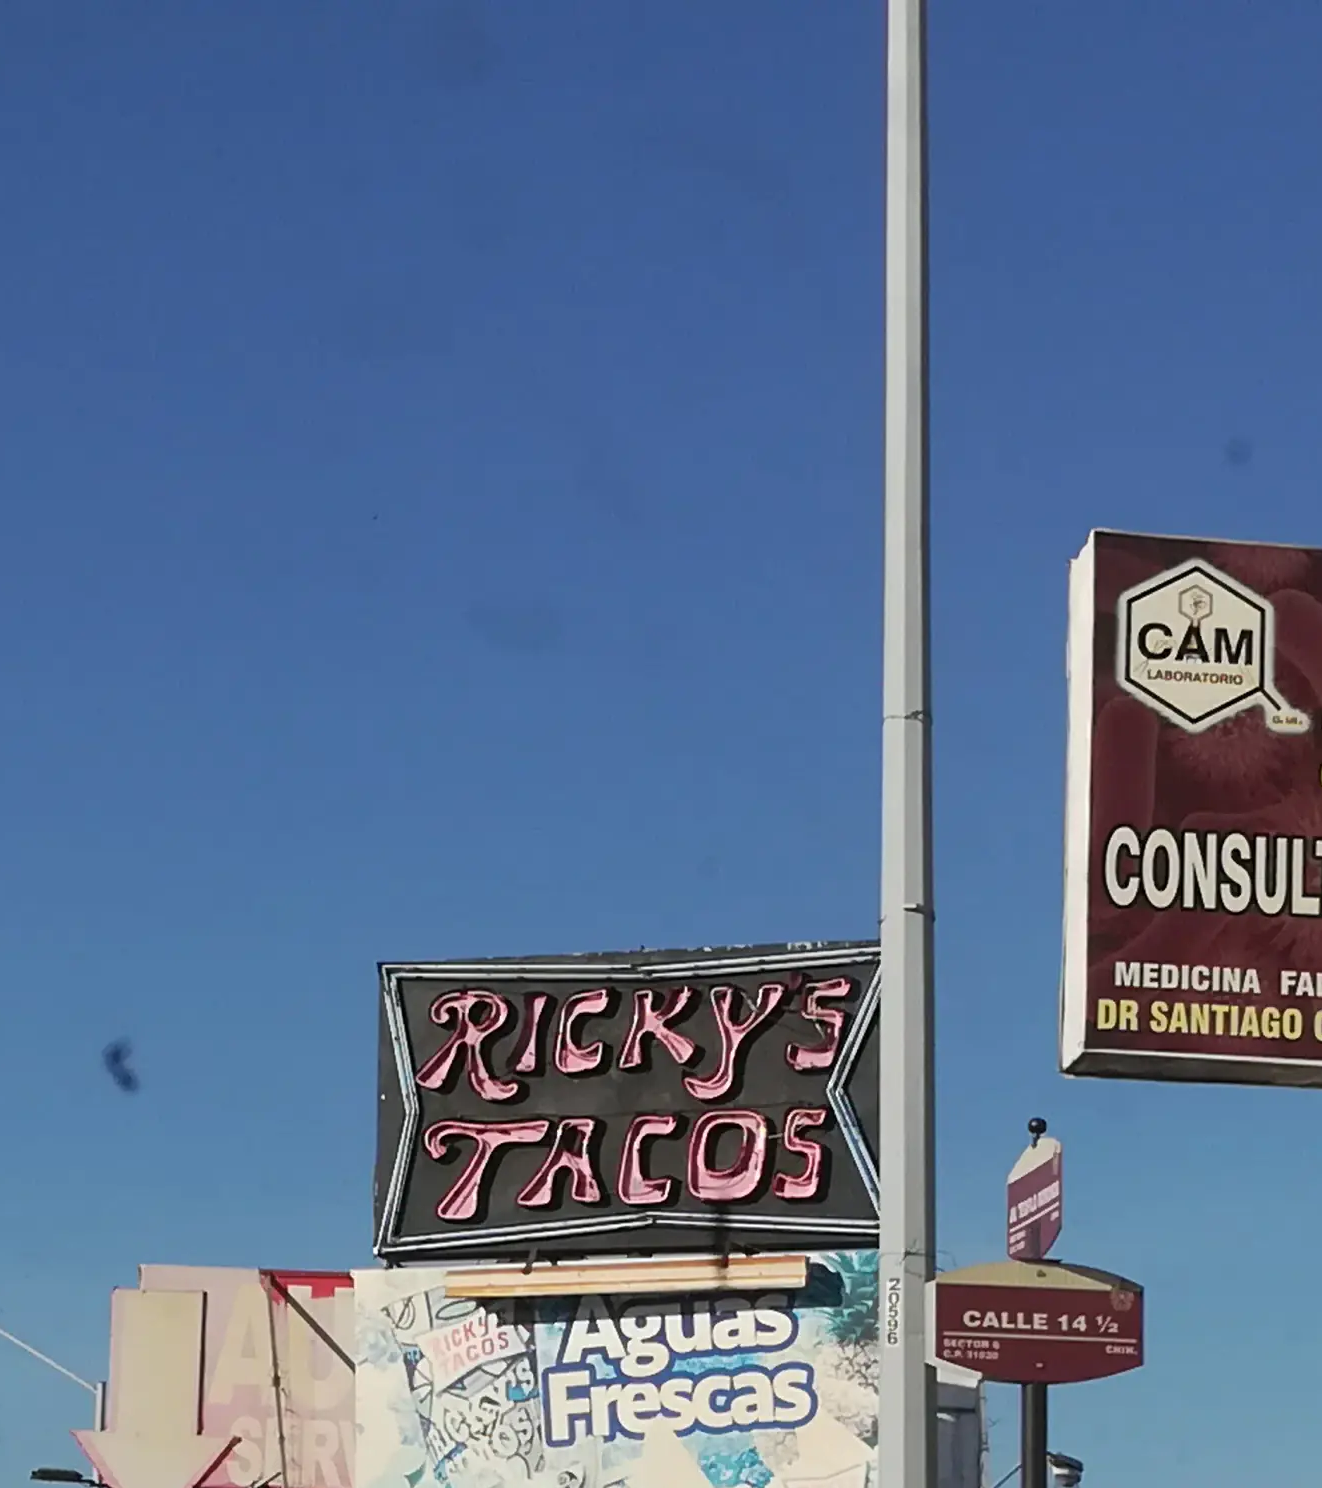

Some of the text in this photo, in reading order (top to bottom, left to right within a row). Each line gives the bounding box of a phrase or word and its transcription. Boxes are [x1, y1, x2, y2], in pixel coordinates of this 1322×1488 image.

[1137, 622, 1254, 666] CAM
[1147, 669, 1243, 685] LABORATORIO
[1114, 961, 1261, 994] MEDICINA
[416, 975, 852, 1100] RICKY'S
[1096, 998, 1139, 1033] DR
[1149, 1002, 1302, 1041] SANTIAGO
[424, 1108, 827, 1223] TACOS
[562, 1294, 793, 1378] Aguas
[963, 1310, 1049, 1330] CALLE
[1057, 1315, 1087, 1332] 14
[943, 1338, 990, 1349] SECTOR
[548, 1367, 812, 1442] Frescas
